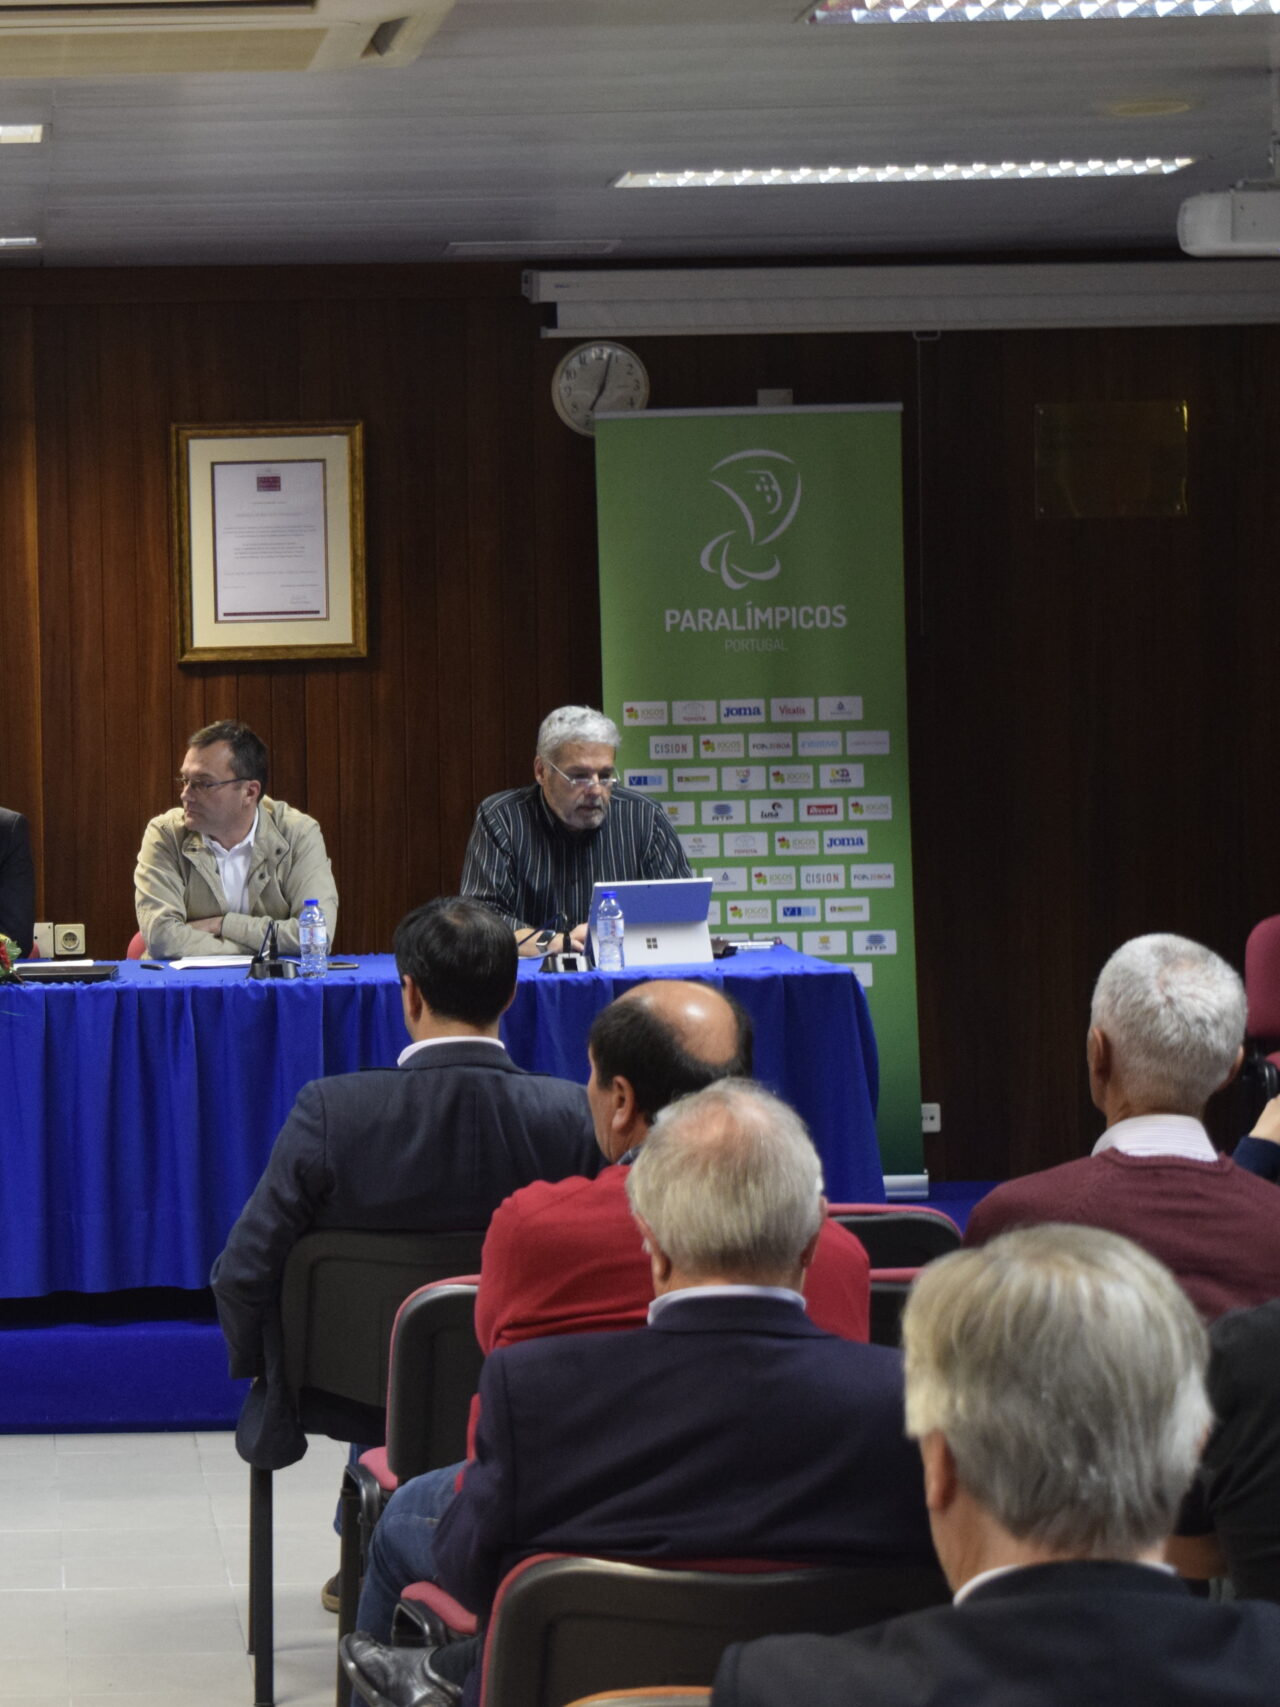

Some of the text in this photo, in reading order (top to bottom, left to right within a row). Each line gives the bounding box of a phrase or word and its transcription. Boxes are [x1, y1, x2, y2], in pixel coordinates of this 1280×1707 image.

[665, 600, 847, 632] PARALÍMPICOS
[724, 637, 785, 652] PORTUGAL
[779, 705, 806, 715] Vitalis
[654, 743, 688, 754] CISION
[805, 872, 840, 884] CISION
